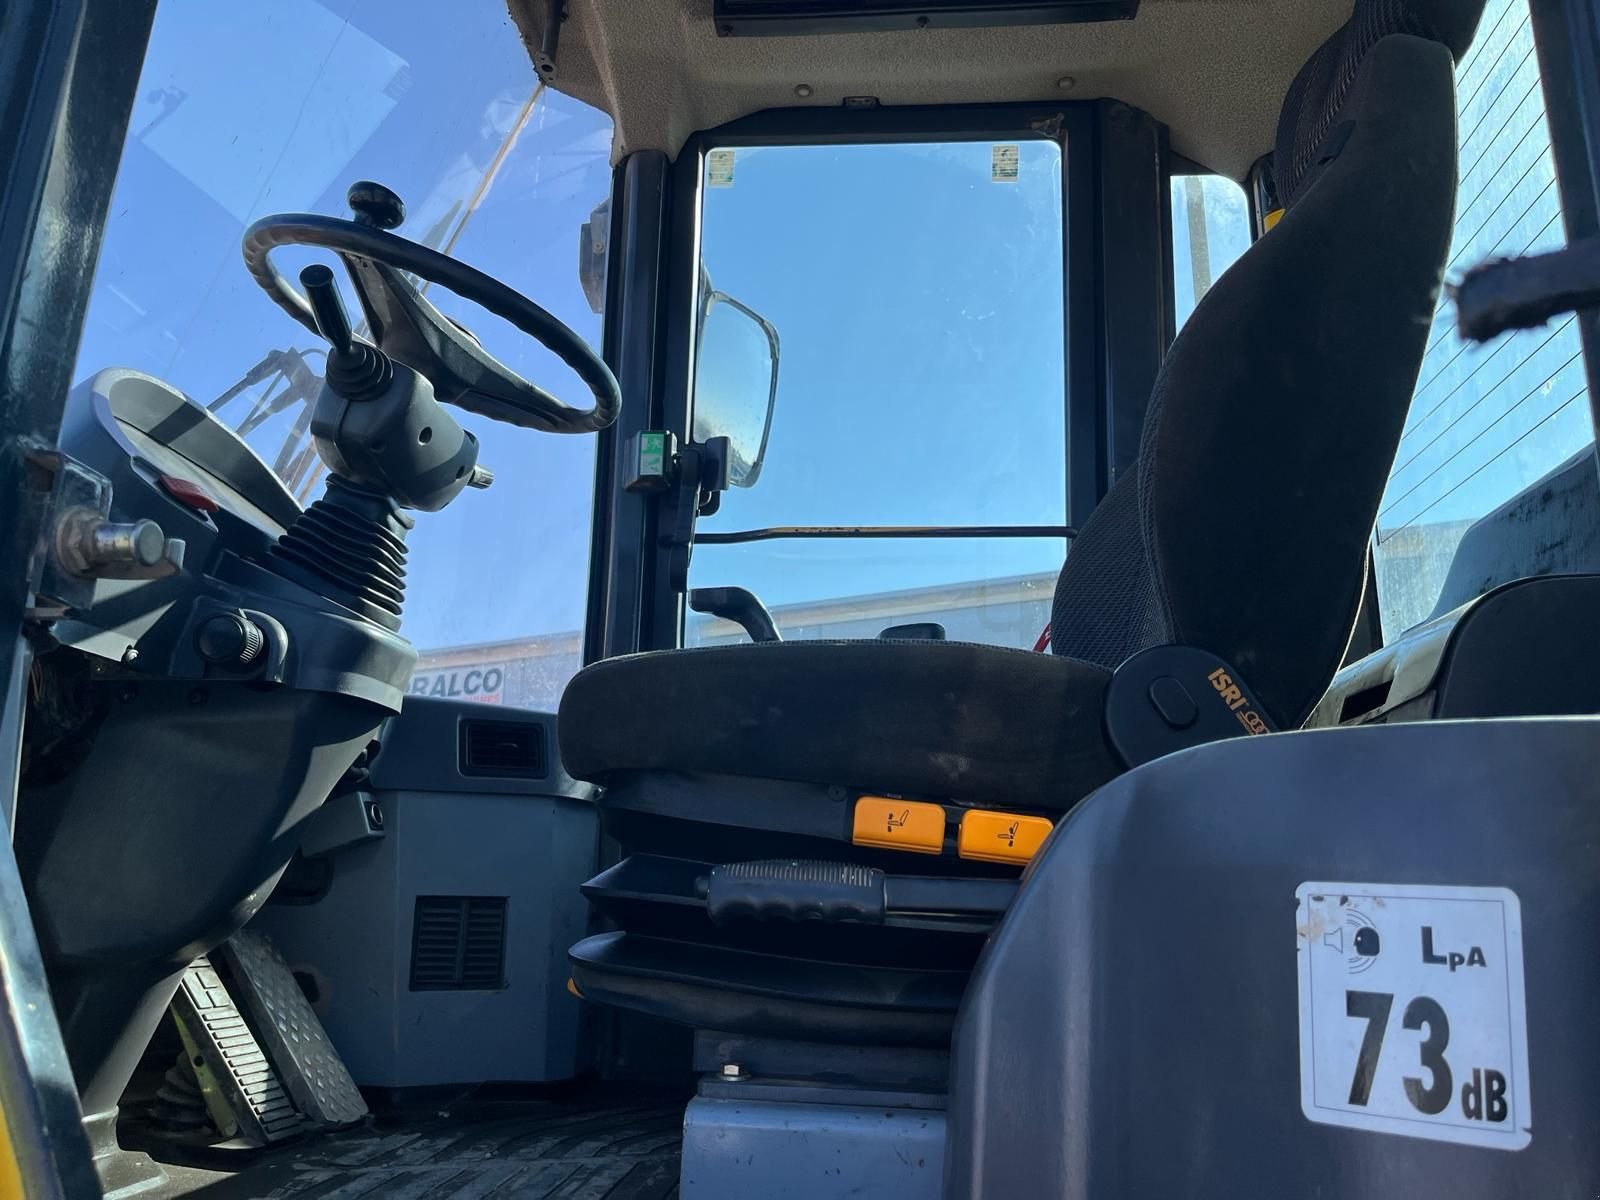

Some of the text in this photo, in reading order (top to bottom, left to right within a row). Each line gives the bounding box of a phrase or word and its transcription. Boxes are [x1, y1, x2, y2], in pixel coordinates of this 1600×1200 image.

[1207, 667, 1247, 711] ISRI
[1421, 925, 1487, 972] LpA
[1345, 989, 1509, 1123] 73 dB
